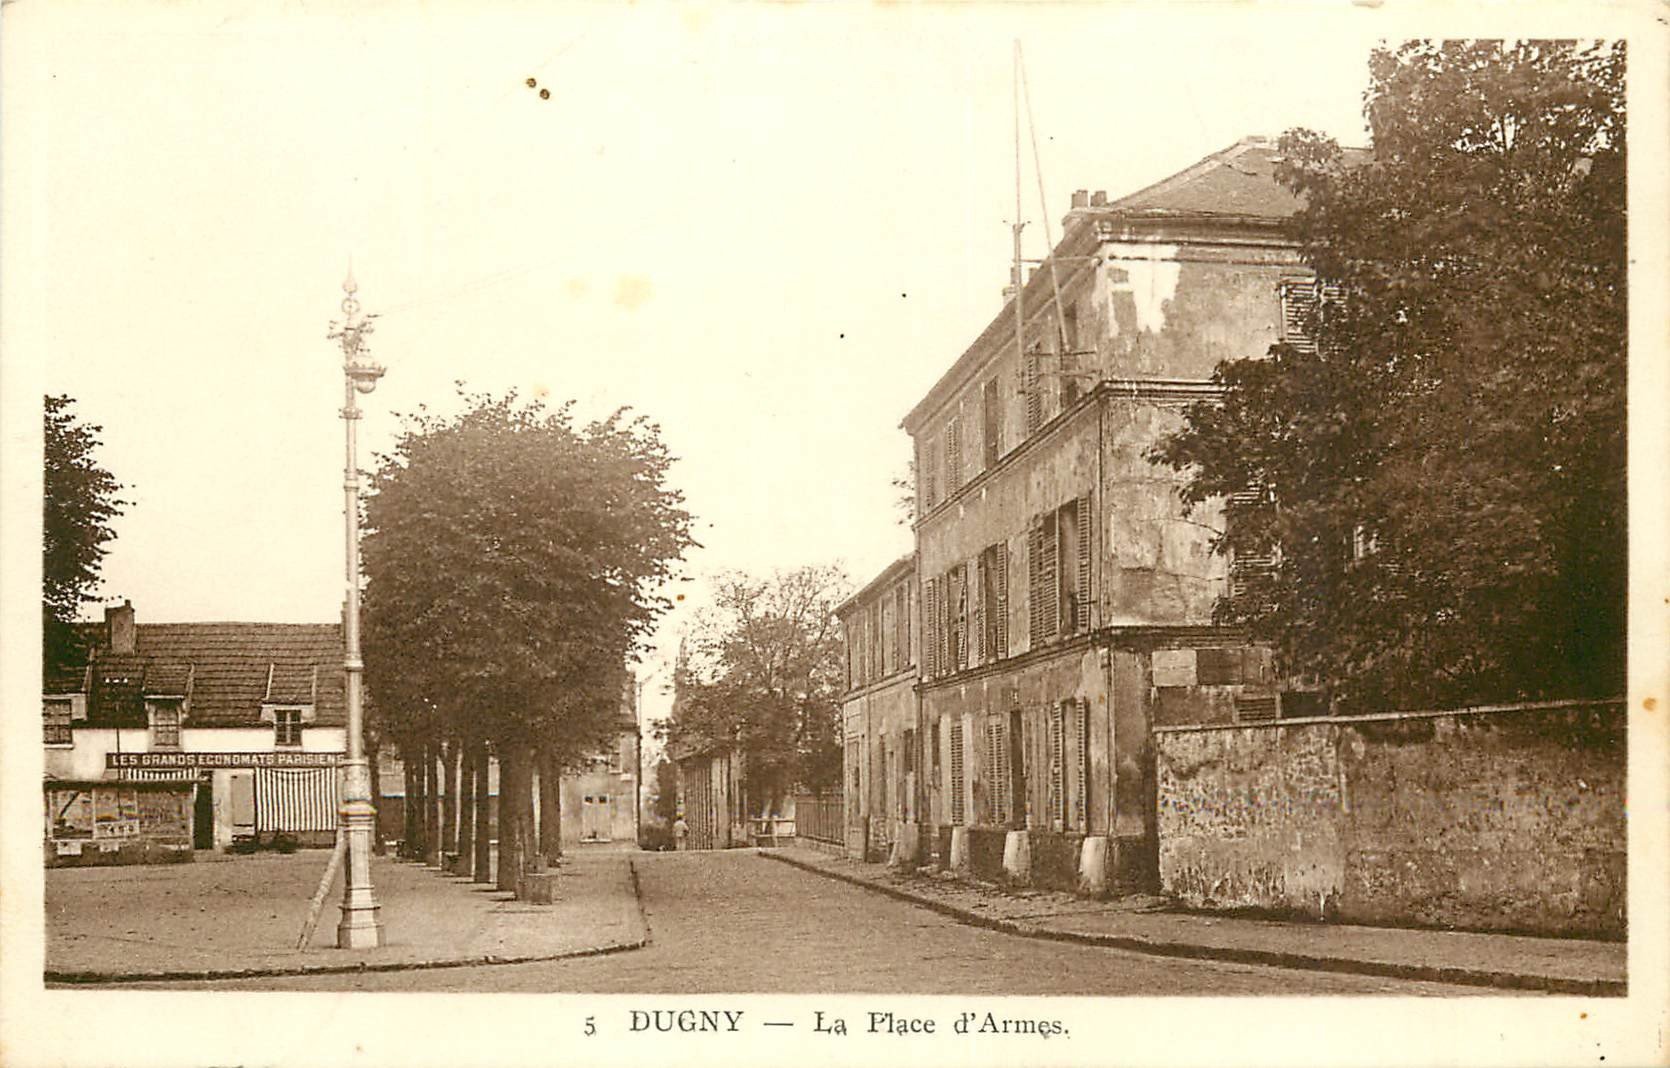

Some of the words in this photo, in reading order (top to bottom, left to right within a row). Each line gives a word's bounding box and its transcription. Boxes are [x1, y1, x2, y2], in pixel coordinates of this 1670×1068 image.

[112, 754, 138, 766] LES
[142, 754, 196, 766] GRANDS
[198, 754, 275, 766] ECONOMATS
